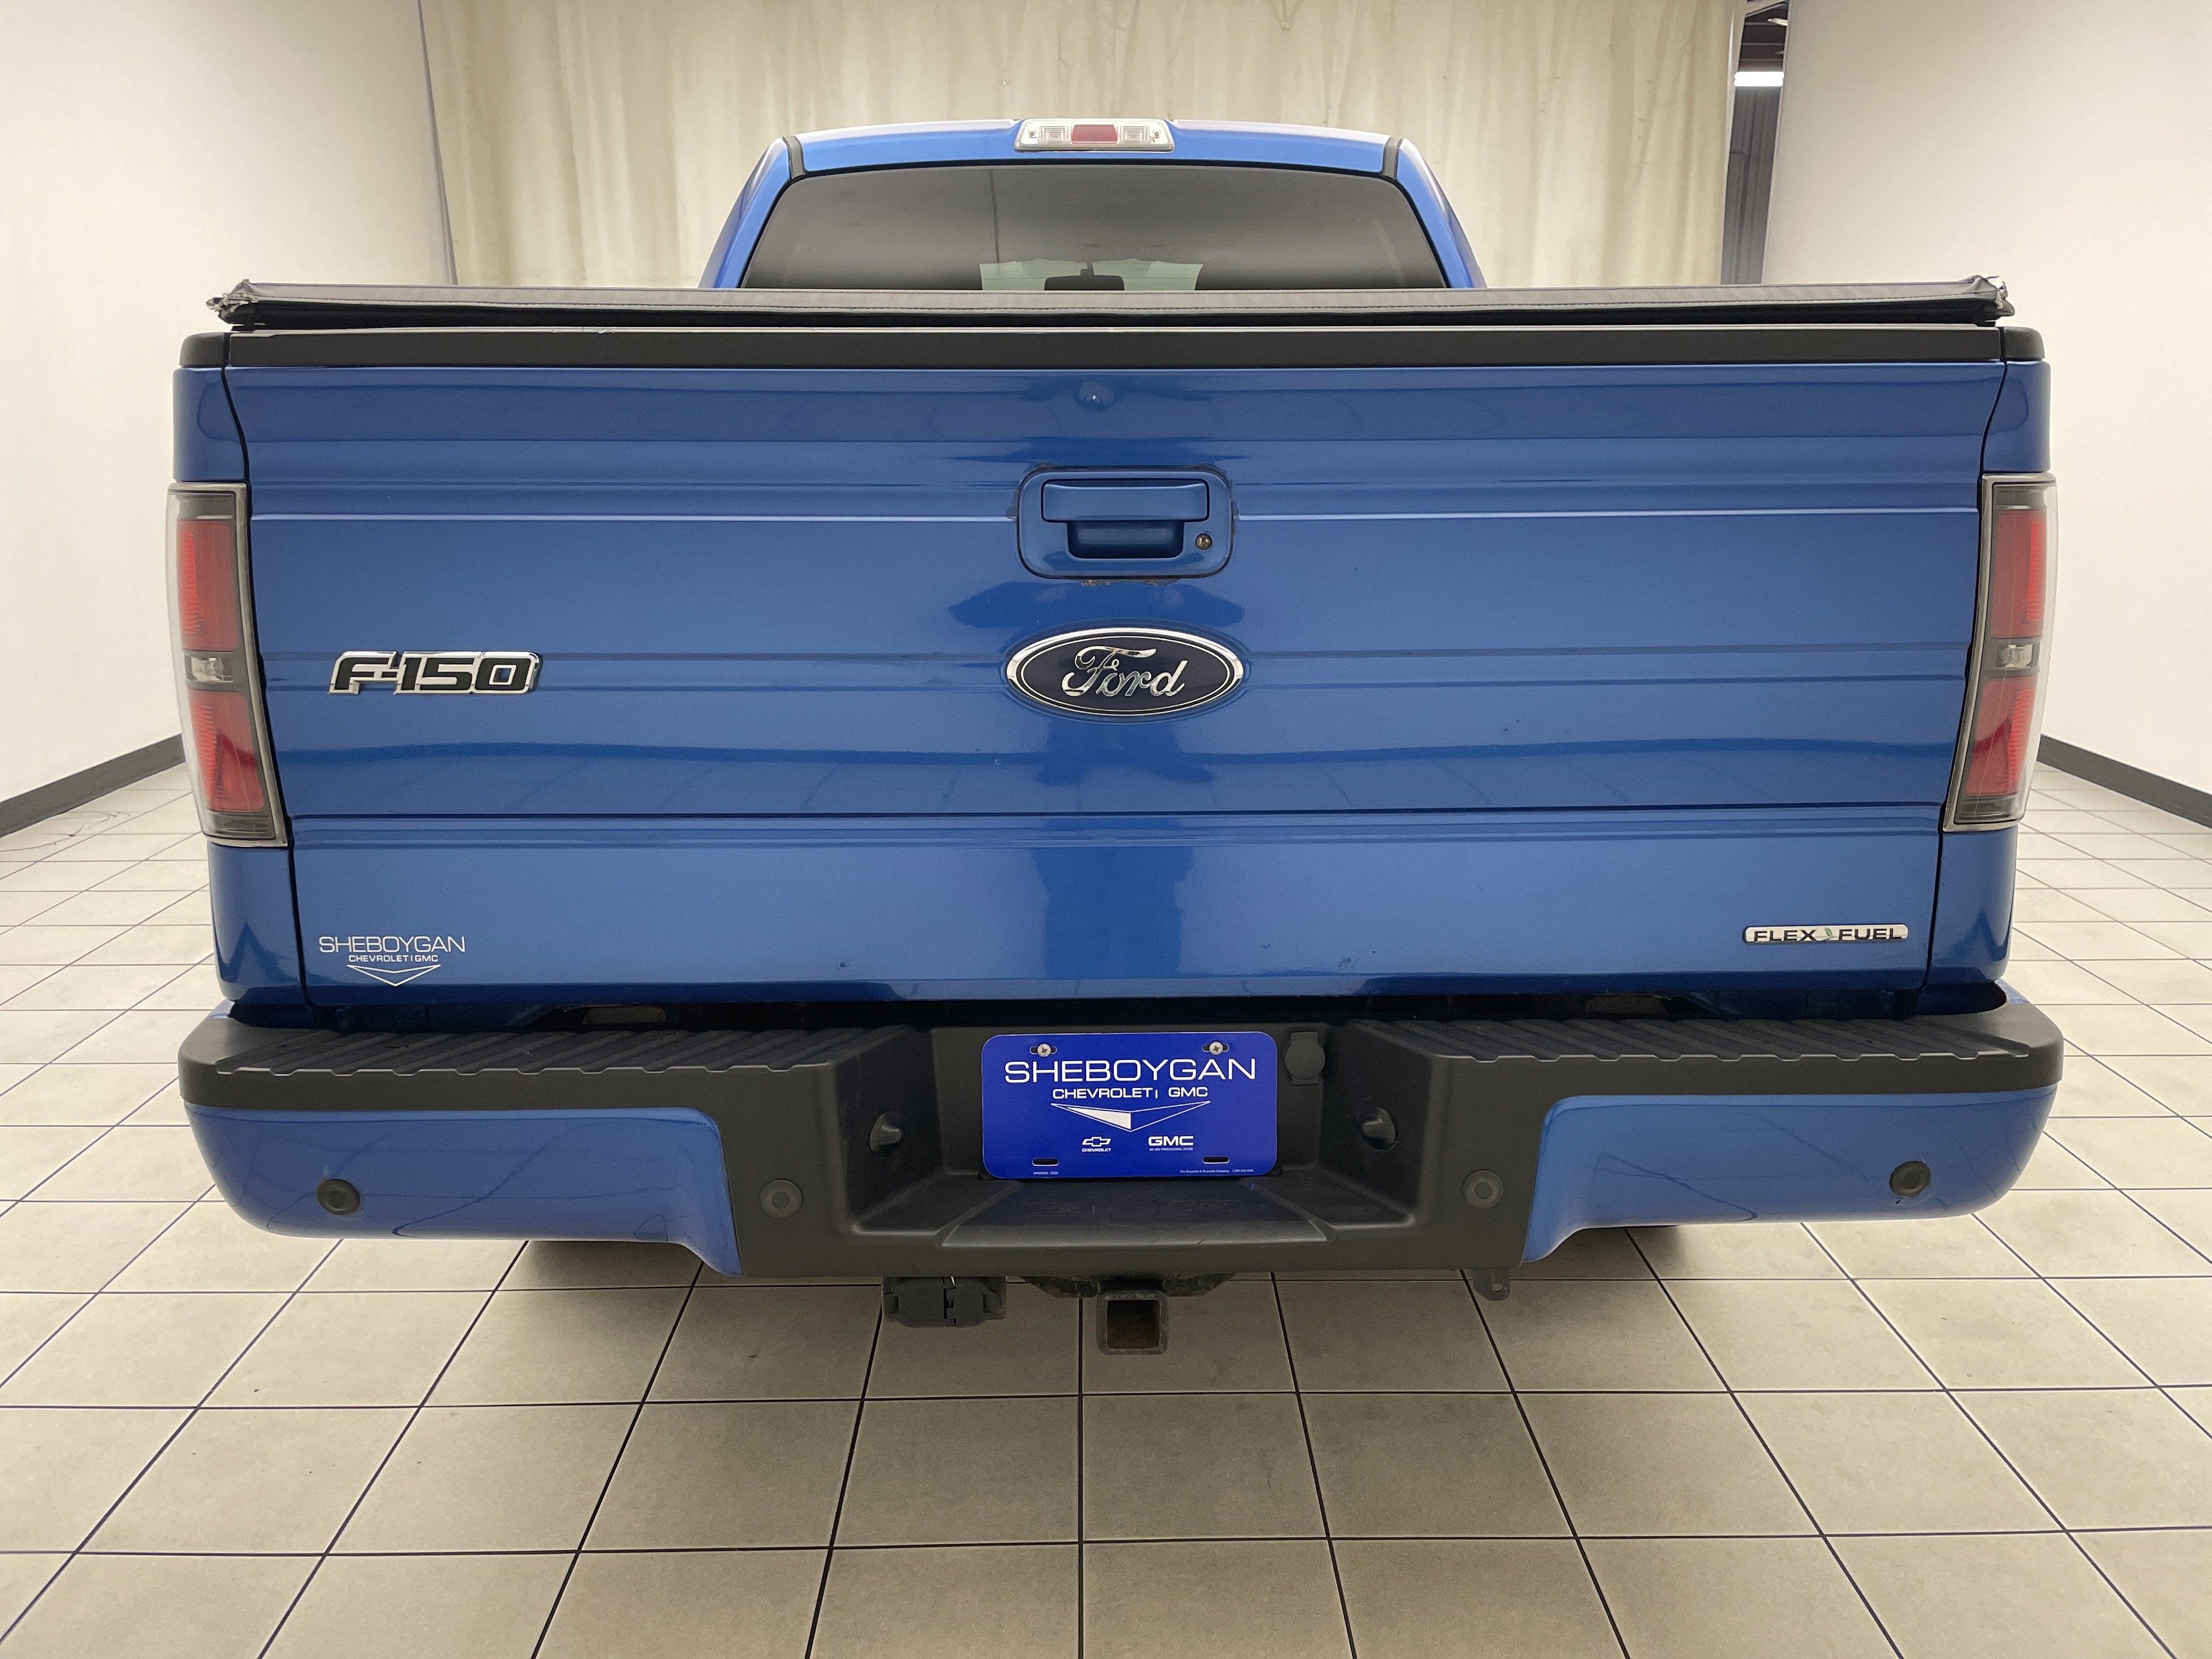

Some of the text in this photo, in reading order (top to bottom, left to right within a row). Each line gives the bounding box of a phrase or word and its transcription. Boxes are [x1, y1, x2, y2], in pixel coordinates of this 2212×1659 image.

[329, 651, 543, 695] F-150
[1061, 645, 1188, 697] Ford
[1754, 928, 1903, 943] FLEX FUEL
[319, 936, 465, 953] SHEBOYGAN
[1005, 1058, 1255, 1083] SHEBOYGAN
[1052, 1086, 1208, 1099] CHEVROLET GMC
[1148, 1136, 1194, 1146] GMC
